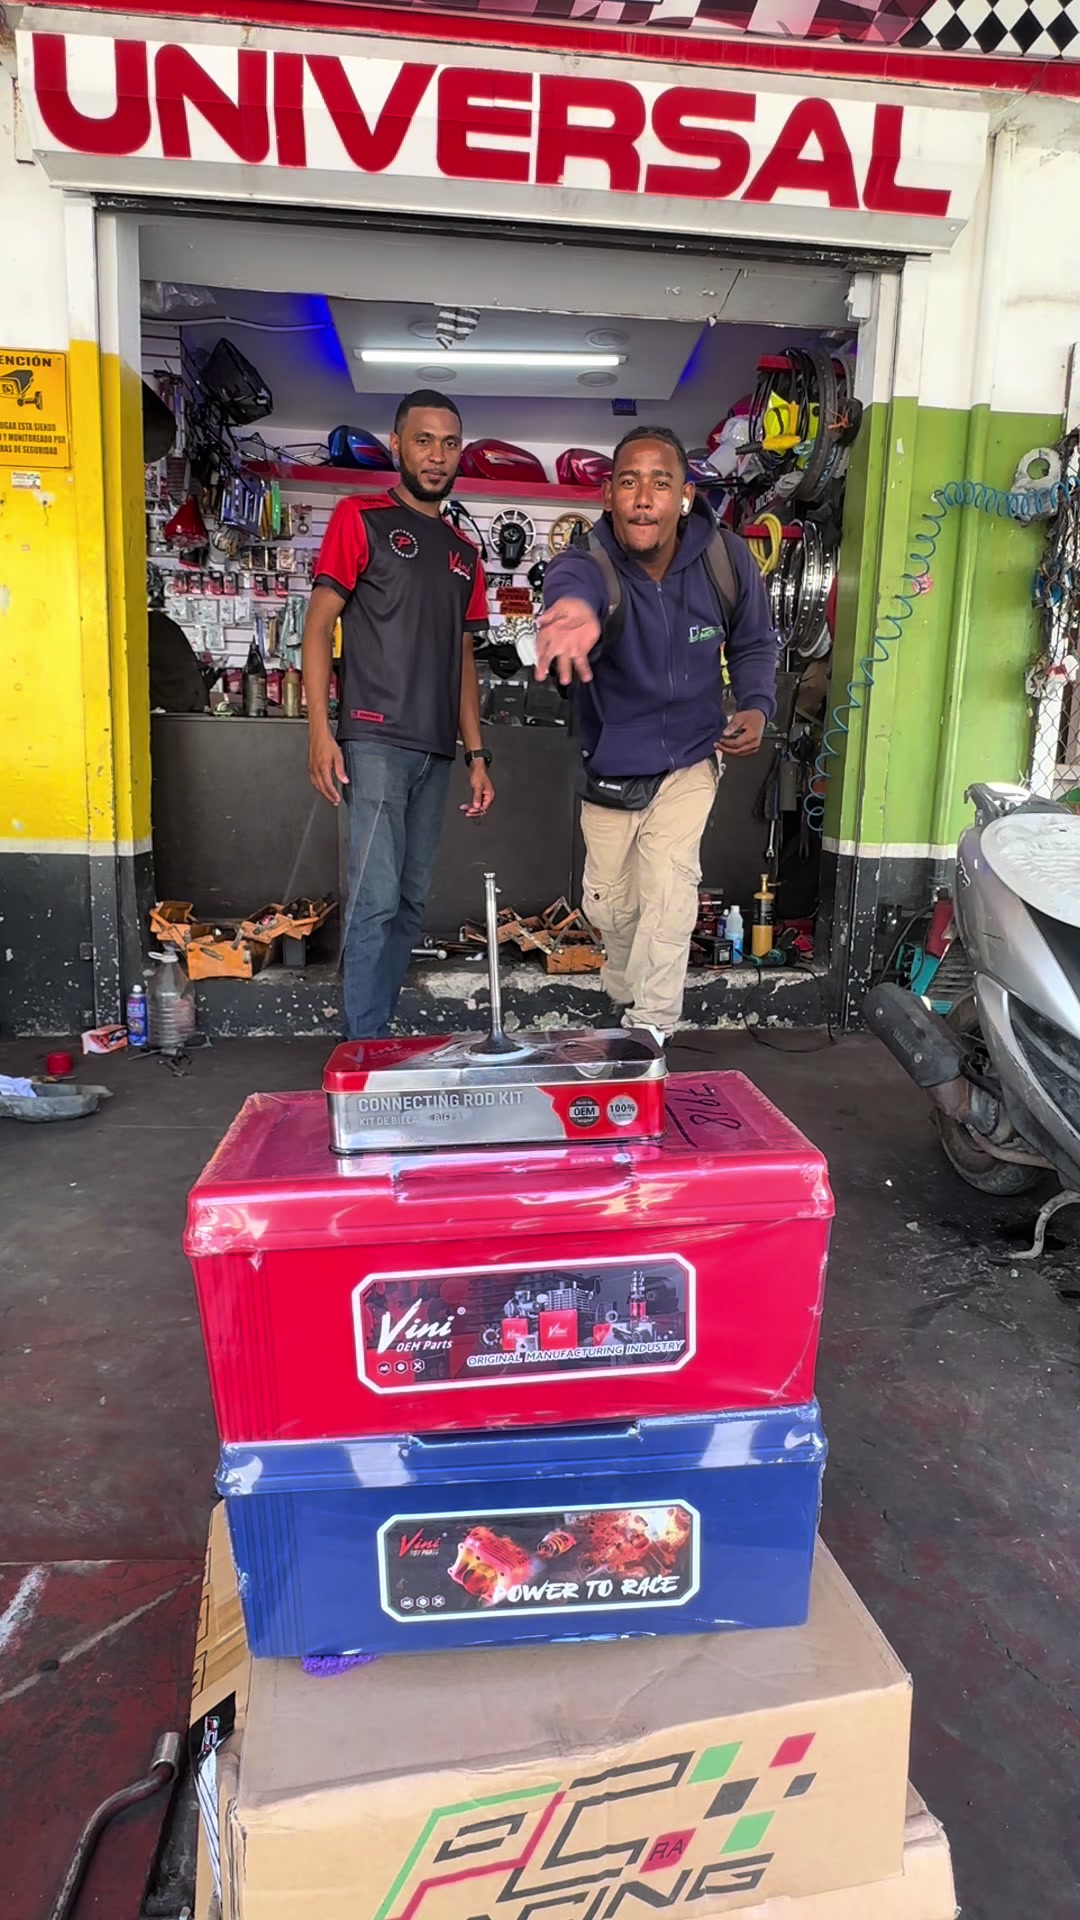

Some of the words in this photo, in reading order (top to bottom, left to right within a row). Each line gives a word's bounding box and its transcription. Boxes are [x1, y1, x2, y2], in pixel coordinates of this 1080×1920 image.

[32, 32, 951, 217] UNIVERSAL
[18, 422, 32, 430] ESTA
[34, 423, 56, 431] SIENDO
[8, 433, 52, 443] MONITOREADO
[54, 435, 66, 444] POR
[14, 445, 21, 453] DE
[23, 445, 58, 455] SEGURIDAD
[358, 1094, 459, 1112] CONNECTING
[464, 1092, 494, 1107] ROD
[500, 1090, 523, 1105] KIT
[573, 1106, 596, 1117] OEM
[610, 1103, 636, 1113] 100%
[359, 1117, 374, 1127] KIT
[377, 1117, 389, 1126] DE
[391, 1115, 419, 1125] BIELA
[377, 1298, 455, 1354] Vini
[396, 1341, 421, 1352] OEM
[422, 1340, 454, 1351] Parts
[466, 1352, 522, 1368] ORIGINAL
[525, 1344, 623, 1363] MANUFACTURING
[625, 1340, 686, 1355] INDUSTRY
[398, 1528, 441, 1557] Vini
[493, 1579, 579, 1603] POWER
[586, 1579, 613, 1599] TO
[620, 1574, 680, 1597] RACE
